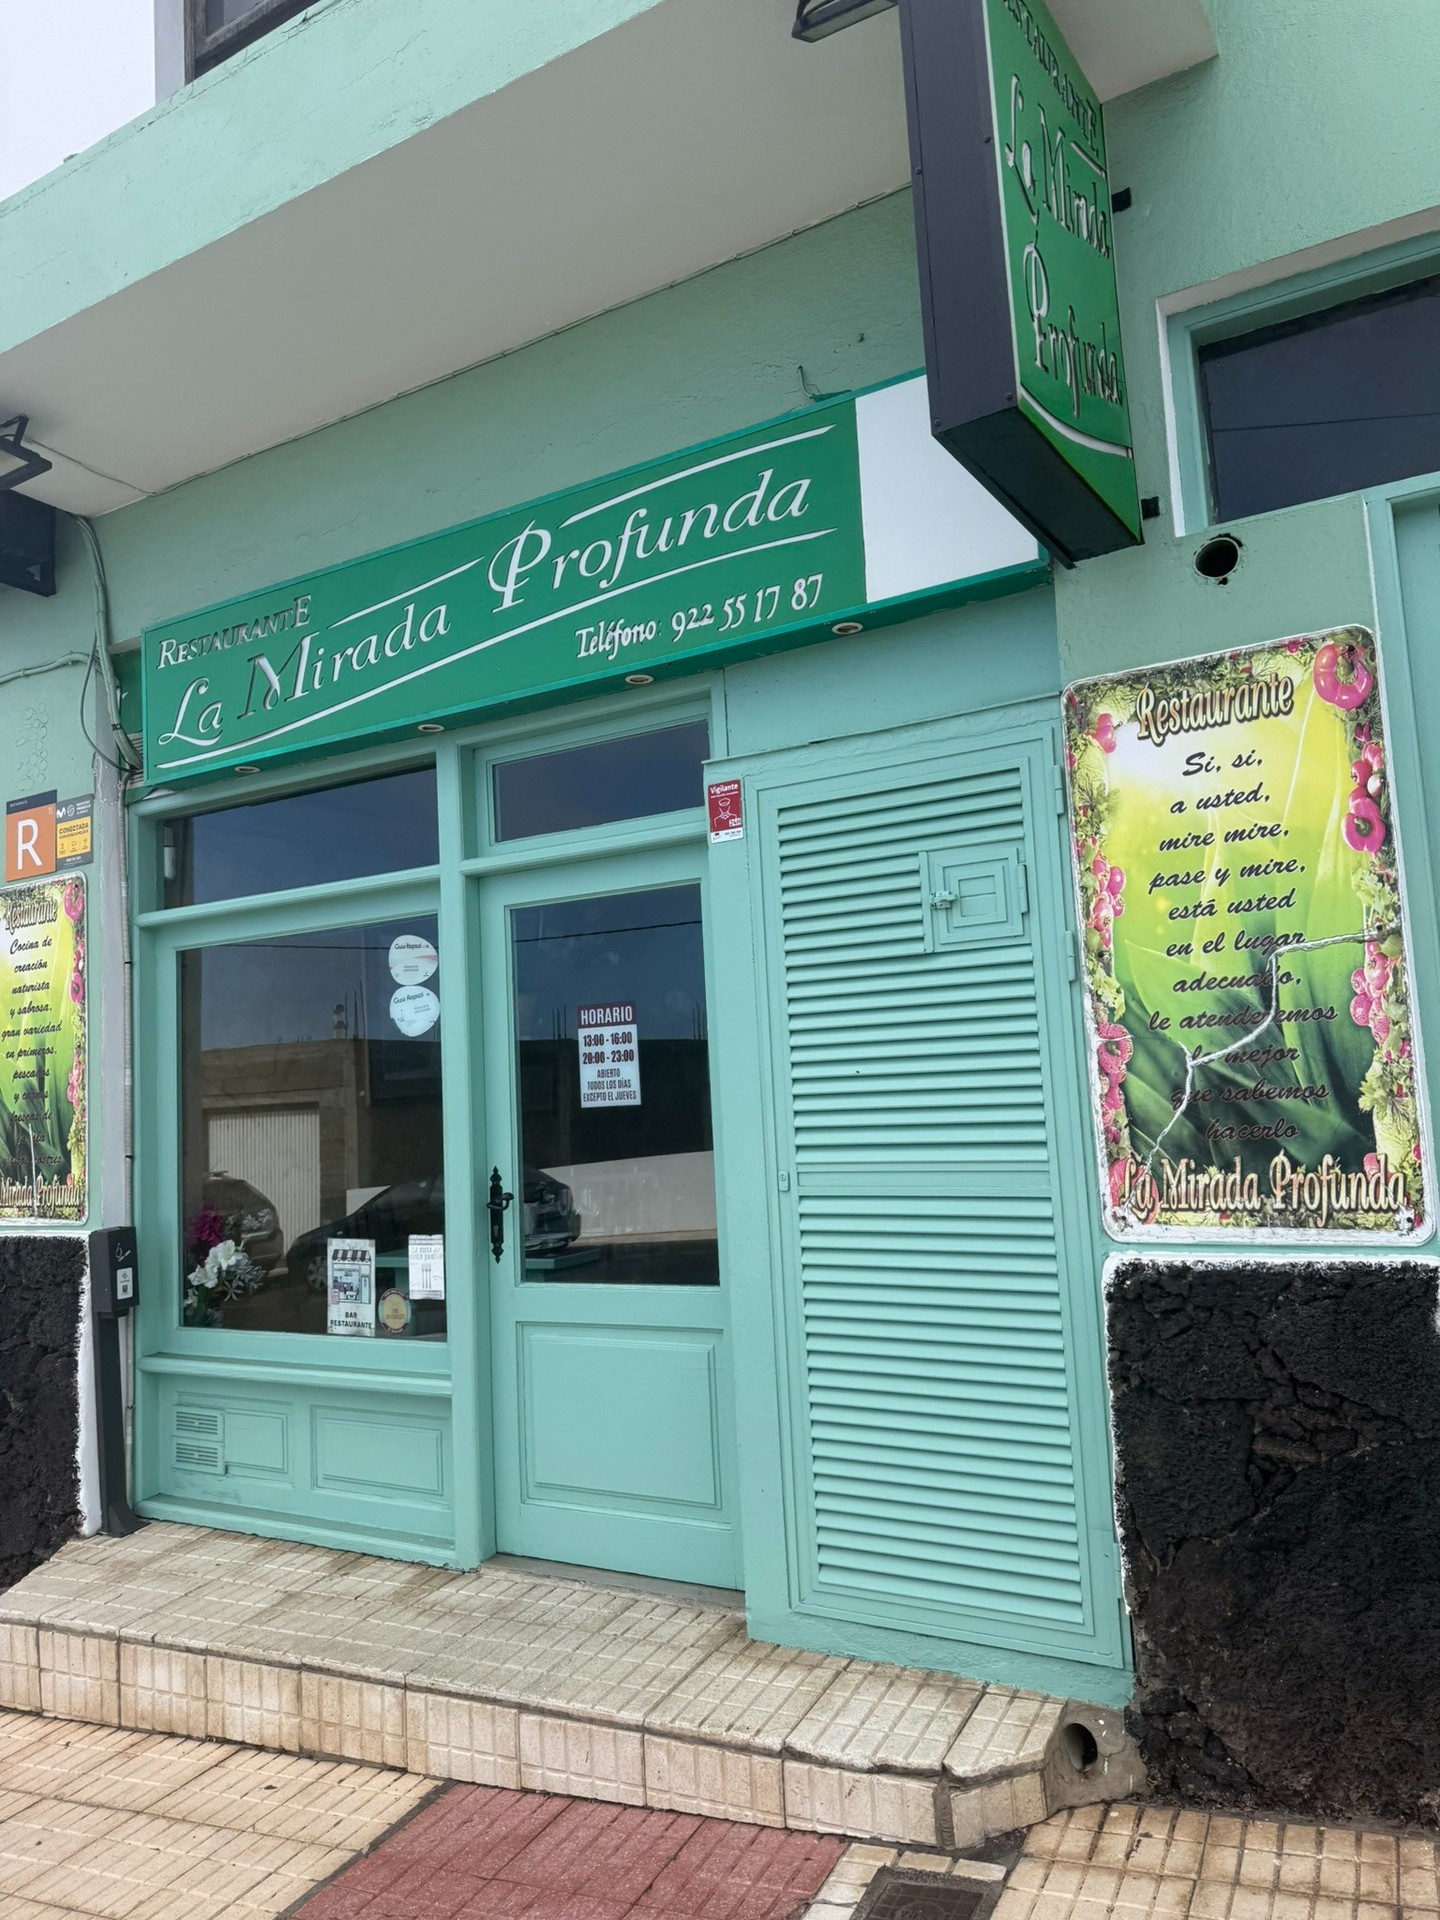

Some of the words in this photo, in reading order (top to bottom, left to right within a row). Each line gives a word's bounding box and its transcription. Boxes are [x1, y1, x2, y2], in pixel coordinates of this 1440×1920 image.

[157, 676, 224, 747] La
[236, 602, 451, 720] Mirada
[487, 467, 812, 615] Profunda
[670, 603, 715, 642] 922
[717, 593, 747, 632] 55
[754, 585, 781, 623] 17
[791, 573, 823, 611] 87
[157, 593, 312, 670] RESTAURANTE
[1136, 681, 1294, 747] Restaurante
[710, 784, 738, 794] Vigilante
[1170, 800, 1187, 814] a
[1196, 781, 1270, 810] usted,
[17, 818, 43, 870] R
[1159, 832, 1215, 851] mire
[1224, 823, 1289, 843] mire,
[1148, 869, 1206, 895] pase
[1215, 867, 1231, 887] y
[1239, 858, 1306, 878] mire,
[1168, 898, 1218, 920] está
[1227, 887, 1297, 914] usted
[10, 938, 39, 955] Cocina
[42, 936, 52, 947] de
[1166, 942, 1193, 957] en
[1202, 931, 1226, 953] el
[1234, 929, 1305, 956] lugar
[12, 981, 50, 994] naturista
[10, 1008, 15, 1019] y
[581, 1006, 633, 1025] HORARIO
[1149, 1010, 1171, 1031] le
[2, 1029, 20, 1042] gran
[24, 1020, 63, 1035] variedad
[583, 1033, 604, 1047] 13:00
[611, 1031, 632, 1044] 16:00
[6, 1051, 15, 1059] en
[583, 1051, 605, 1065] 20:00
[611, 1049, 634, 1062] 23:00
[1225, 1044, 1300, 1068] mejor
[597, 1068, 620, 1078] ABIERTO
[587, 1080, 605, 1090] TODOS
[606, 1080, 616, 1089] LOS
[1171, 1087, 1214, 1111] que
[1221, 1077, 1330, 1101] sabemos
[13, 1093, 19, 1104] y
[583, 1091, 607, 1102] EXCEPTO
[608, 1091, 614, 1101] EL
[615, 1090, 637, 1100] JUEVES
[1206, 1117, 1299, 1140] hacerlo
[1160, 1155, 1261, 1211] Mirada
[1268, 1147, 1408, 1228] Profunda
[330, 1319, 372, 1330] RESTAURANTE
[345, 1311, 358, 1319] BAR
